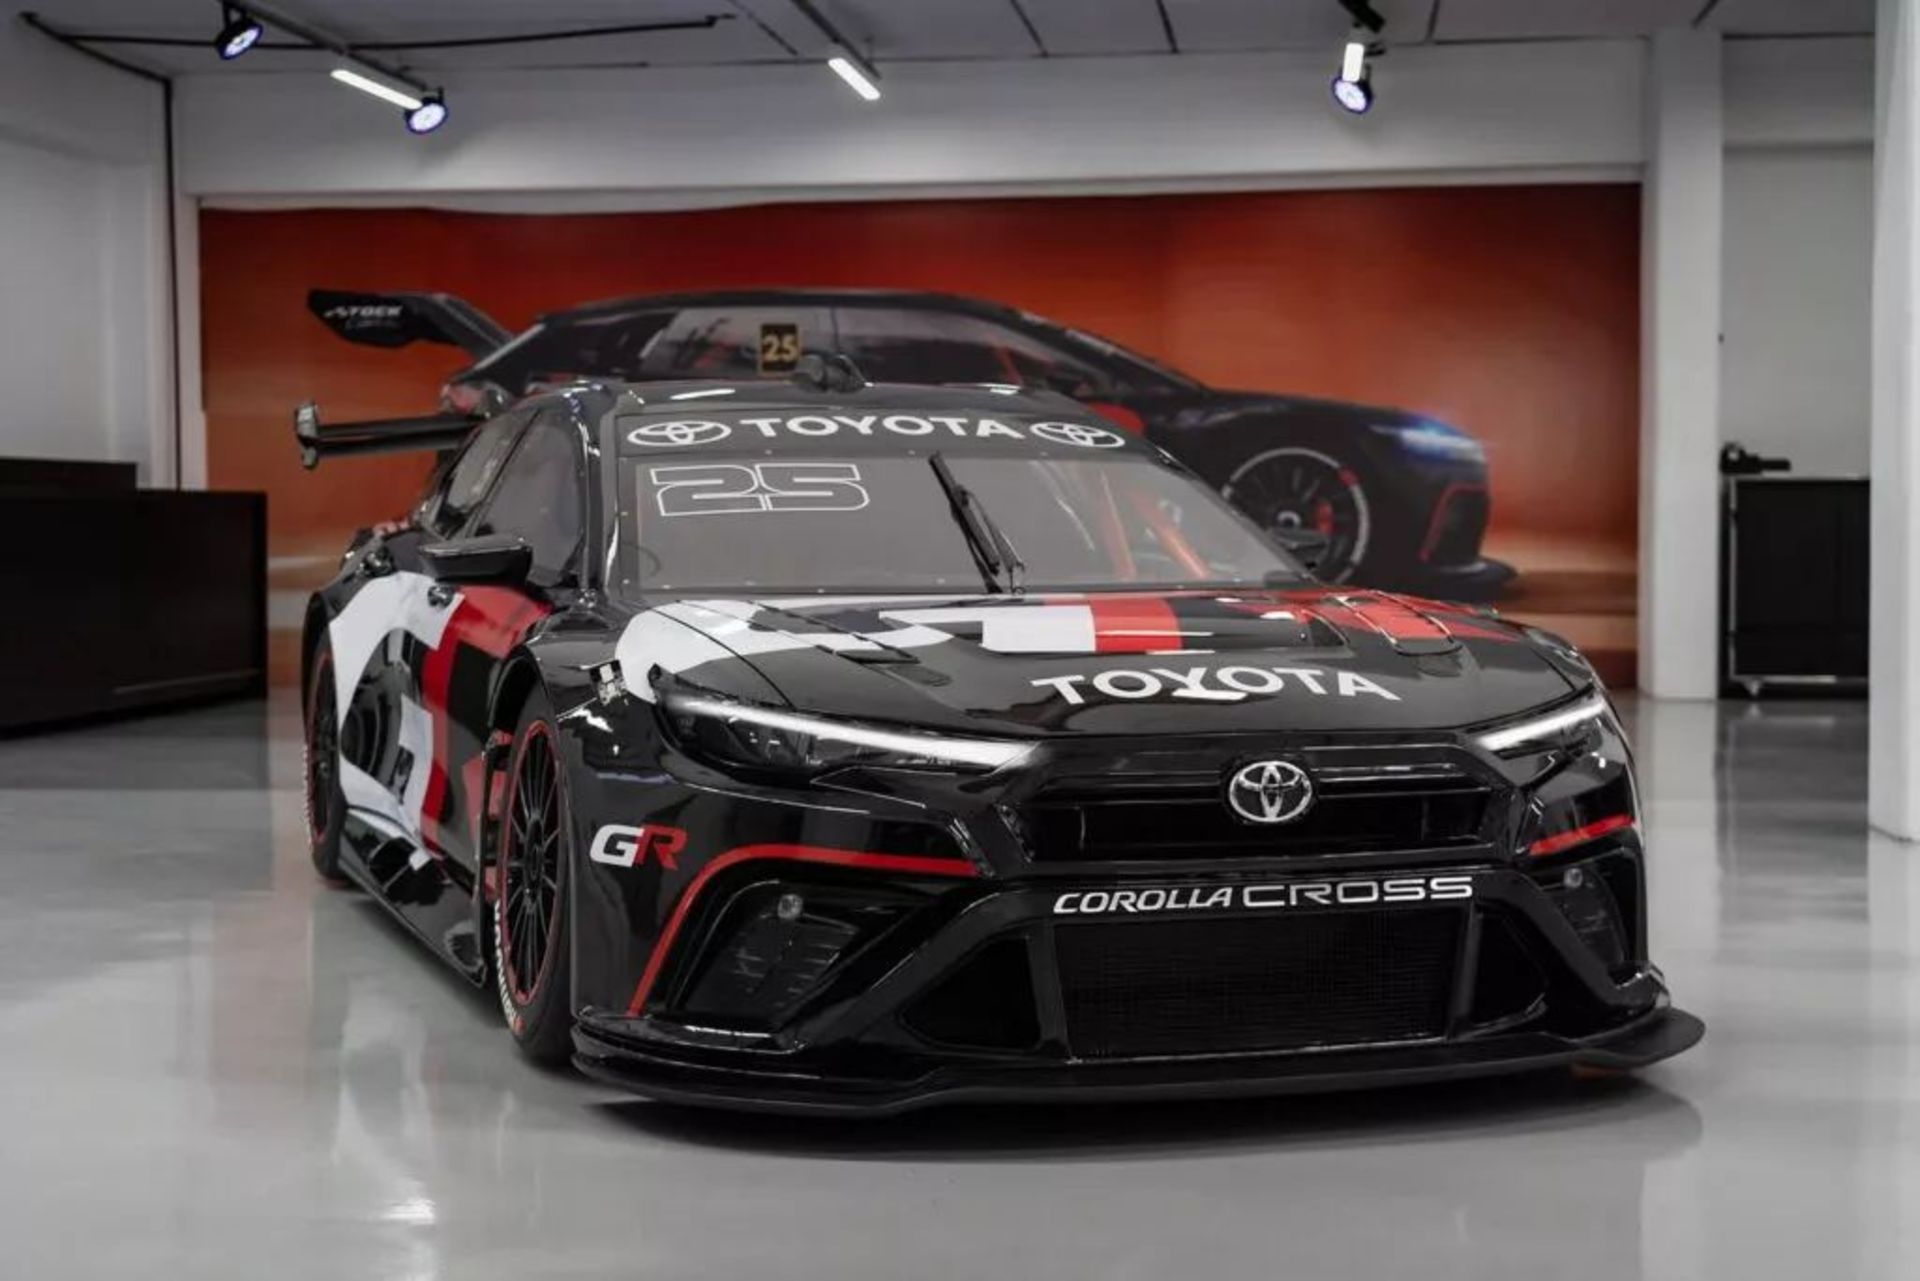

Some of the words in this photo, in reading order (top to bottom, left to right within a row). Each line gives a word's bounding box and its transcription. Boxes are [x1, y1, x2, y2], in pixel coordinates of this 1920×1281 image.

[762, 333, 799, 362] 25
[739, 415, 1026, 440] TOYOTA
[649, 463, 870, 517] 25
[1030, 665, 1402, 706] TOYOTA
[589, 823, 688, 871] GR
[1053, 886, 1234, 915] COROLLA
[1242, 875, 1473, 908] CROSS
